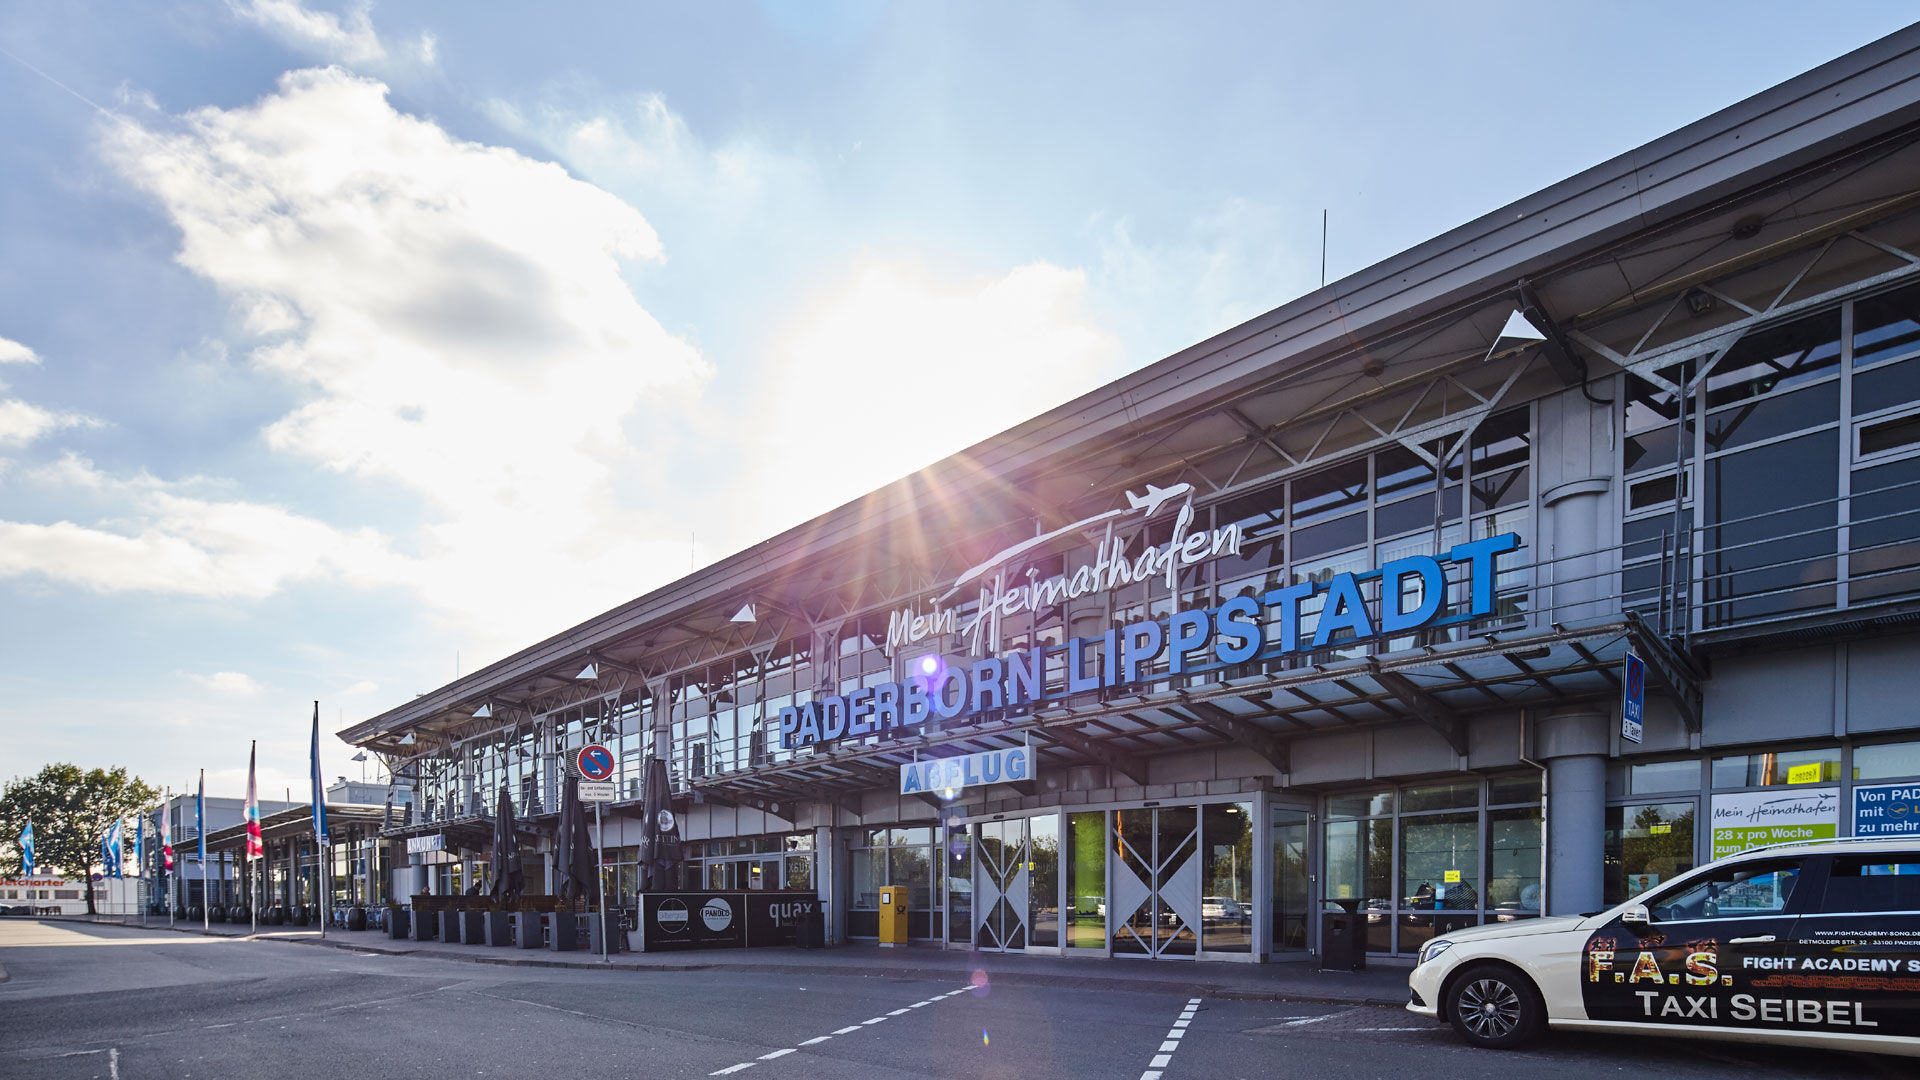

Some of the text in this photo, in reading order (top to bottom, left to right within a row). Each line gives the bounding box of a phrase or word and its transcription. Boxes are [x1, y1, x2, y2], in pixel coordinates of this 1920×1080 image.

[885, 504, 1241, 657] Mein Heimathafen
[779, 532, 1520, 749] PADERBORN LIPPSTADT
[1628, 700, 1641, 719] TAXI
[904, 750, 1026, 792] ABFLUG
[1859, 788, 1920, 802] Von PAD
[1714, 801, 1836, 822] Mein Heimathafen
[1859, 806, 1884, 818] mit
[1716, 830, 1733, 841] 28
[1747, 831, 1767, 842] pro
[1771, 828, 1813, 839] Woche
[1859, 820, 1919, 833] zu mehr
[1715, 845, 1741, 854] zum
[1589, 951, 1733, 986] F.A.S.
[1743, 957, 1796, 970] FIGHT
[1801, 957, 1902, 972] ACADEMY
[1635, 990, 1878, 1026] TAXI SEIBEL
